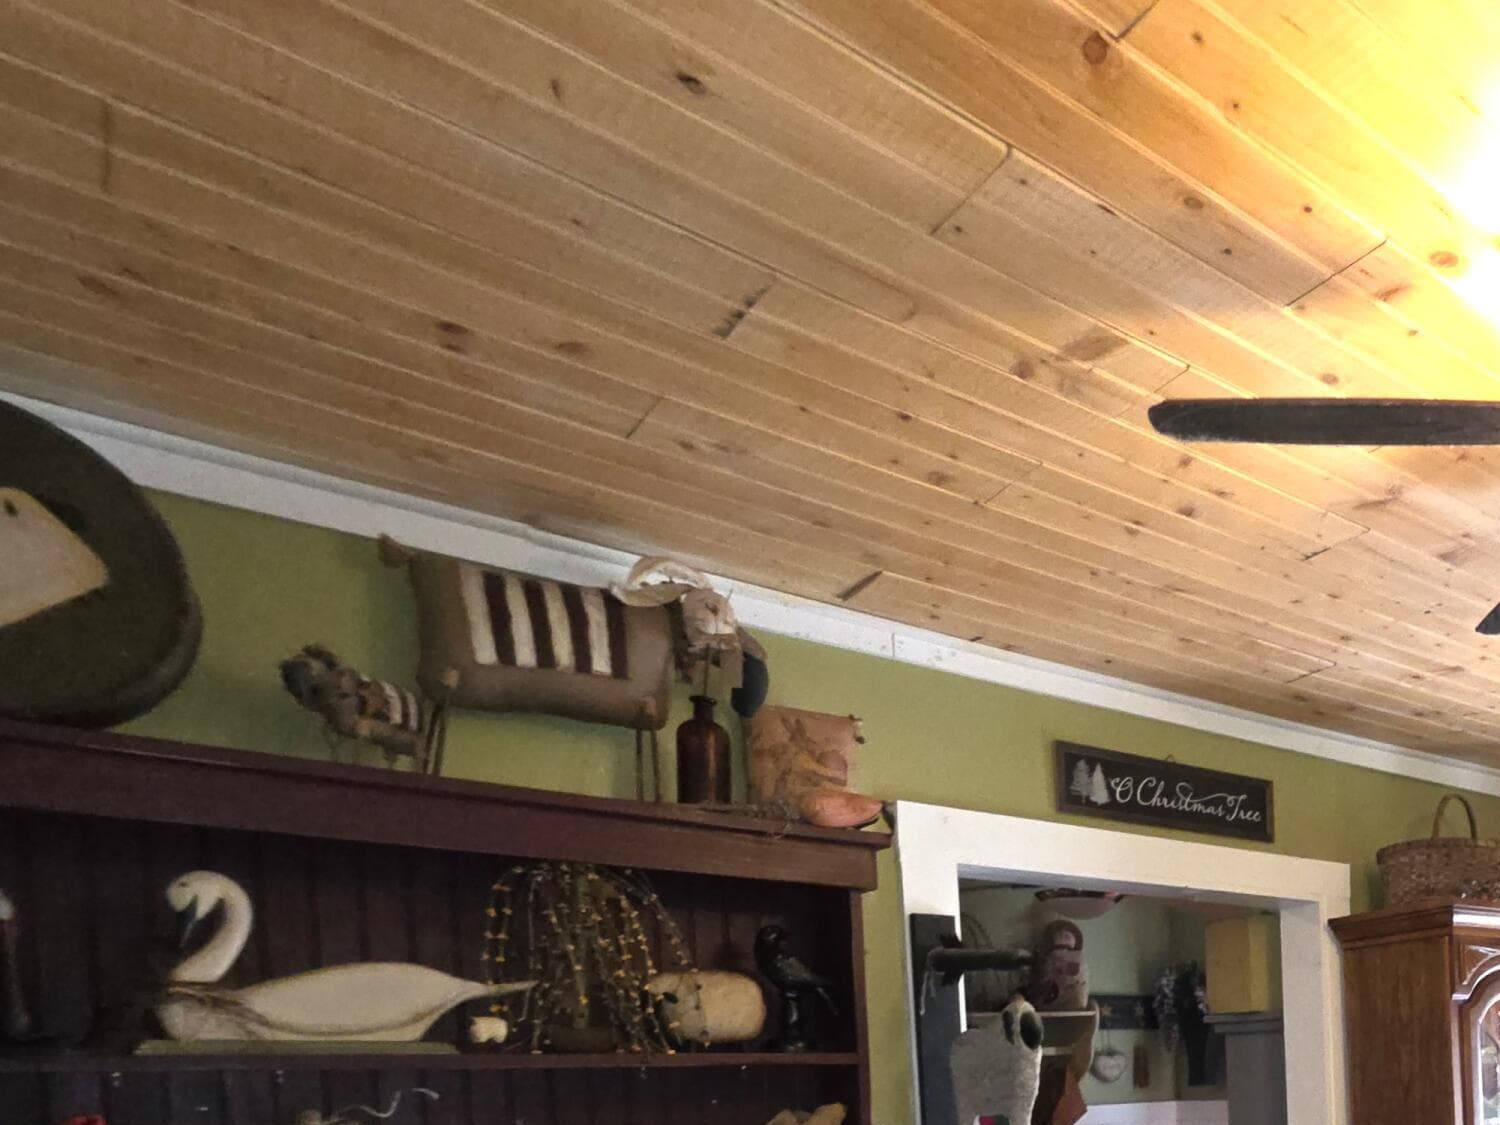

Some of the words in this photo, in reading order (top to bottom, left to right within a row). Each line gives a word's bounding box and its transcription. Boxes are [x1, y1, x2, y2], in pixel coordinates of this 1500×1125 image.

[1109, 776, 1134, 804] O
[1137, 776, 1226, 817] Christmas
[1226, 794, 1262, 822] Tree
